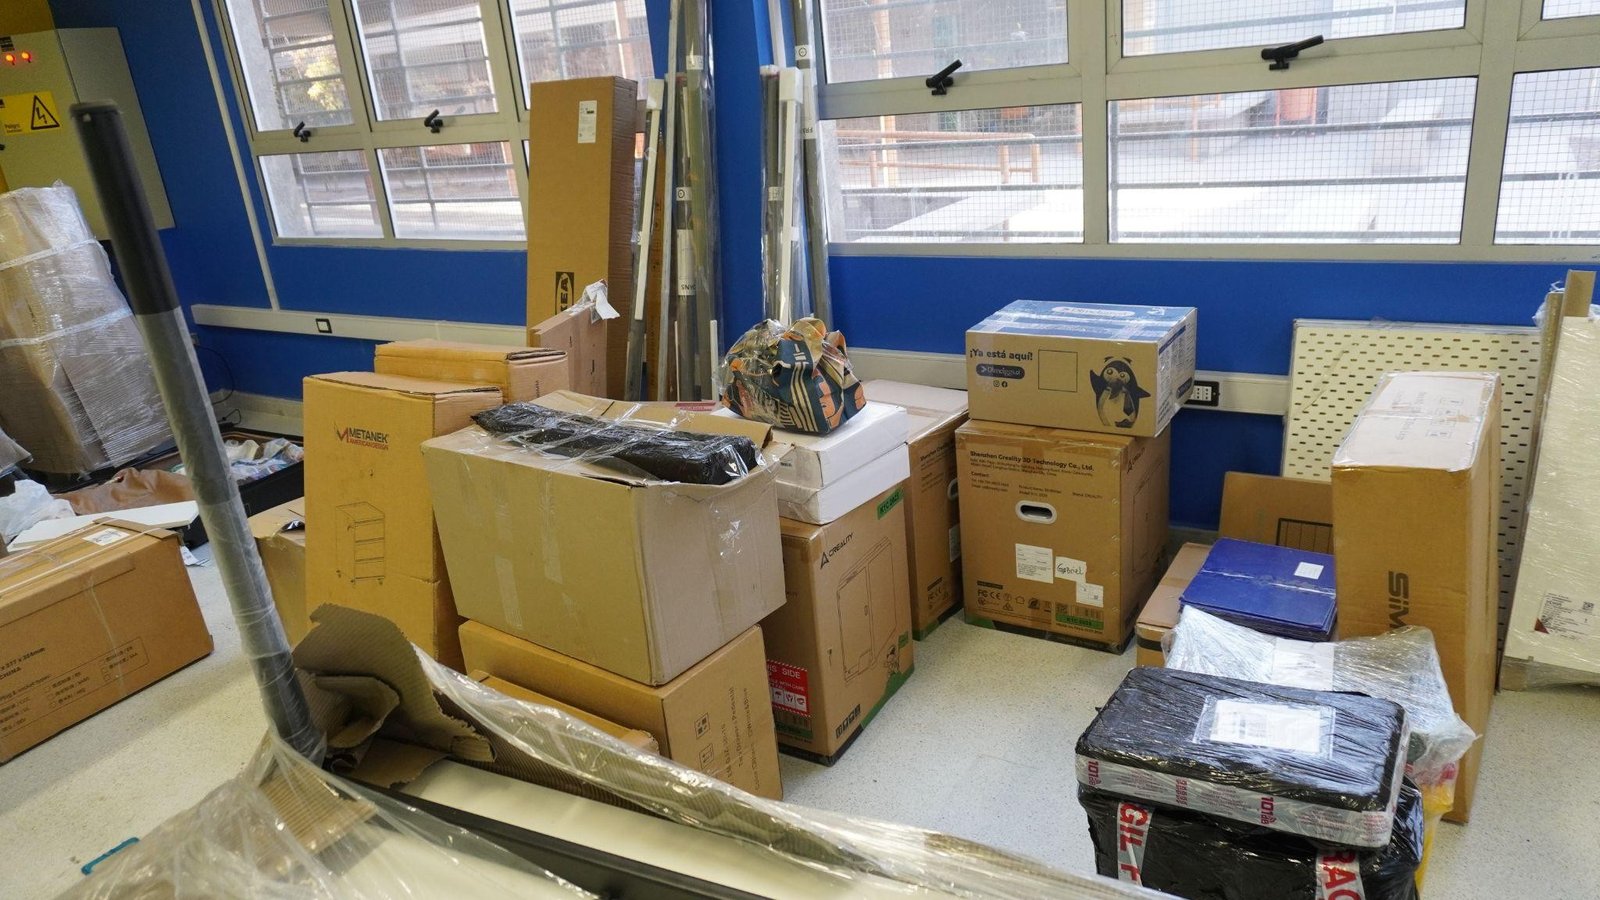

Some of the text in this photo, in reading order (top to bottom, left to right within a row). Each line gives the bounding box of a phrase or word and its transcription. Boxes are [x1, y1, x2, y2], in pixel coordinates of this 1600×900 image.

[986, 350, 1006, 359] está
[1008, 351, 1033, 362] aquí!
[348, 427, 389, 444] METANEK
[998, 453, 1021, 463] Creality
[1032, 458, 1067, 469] Technology
[782, 667, 801, 679] SIDE
